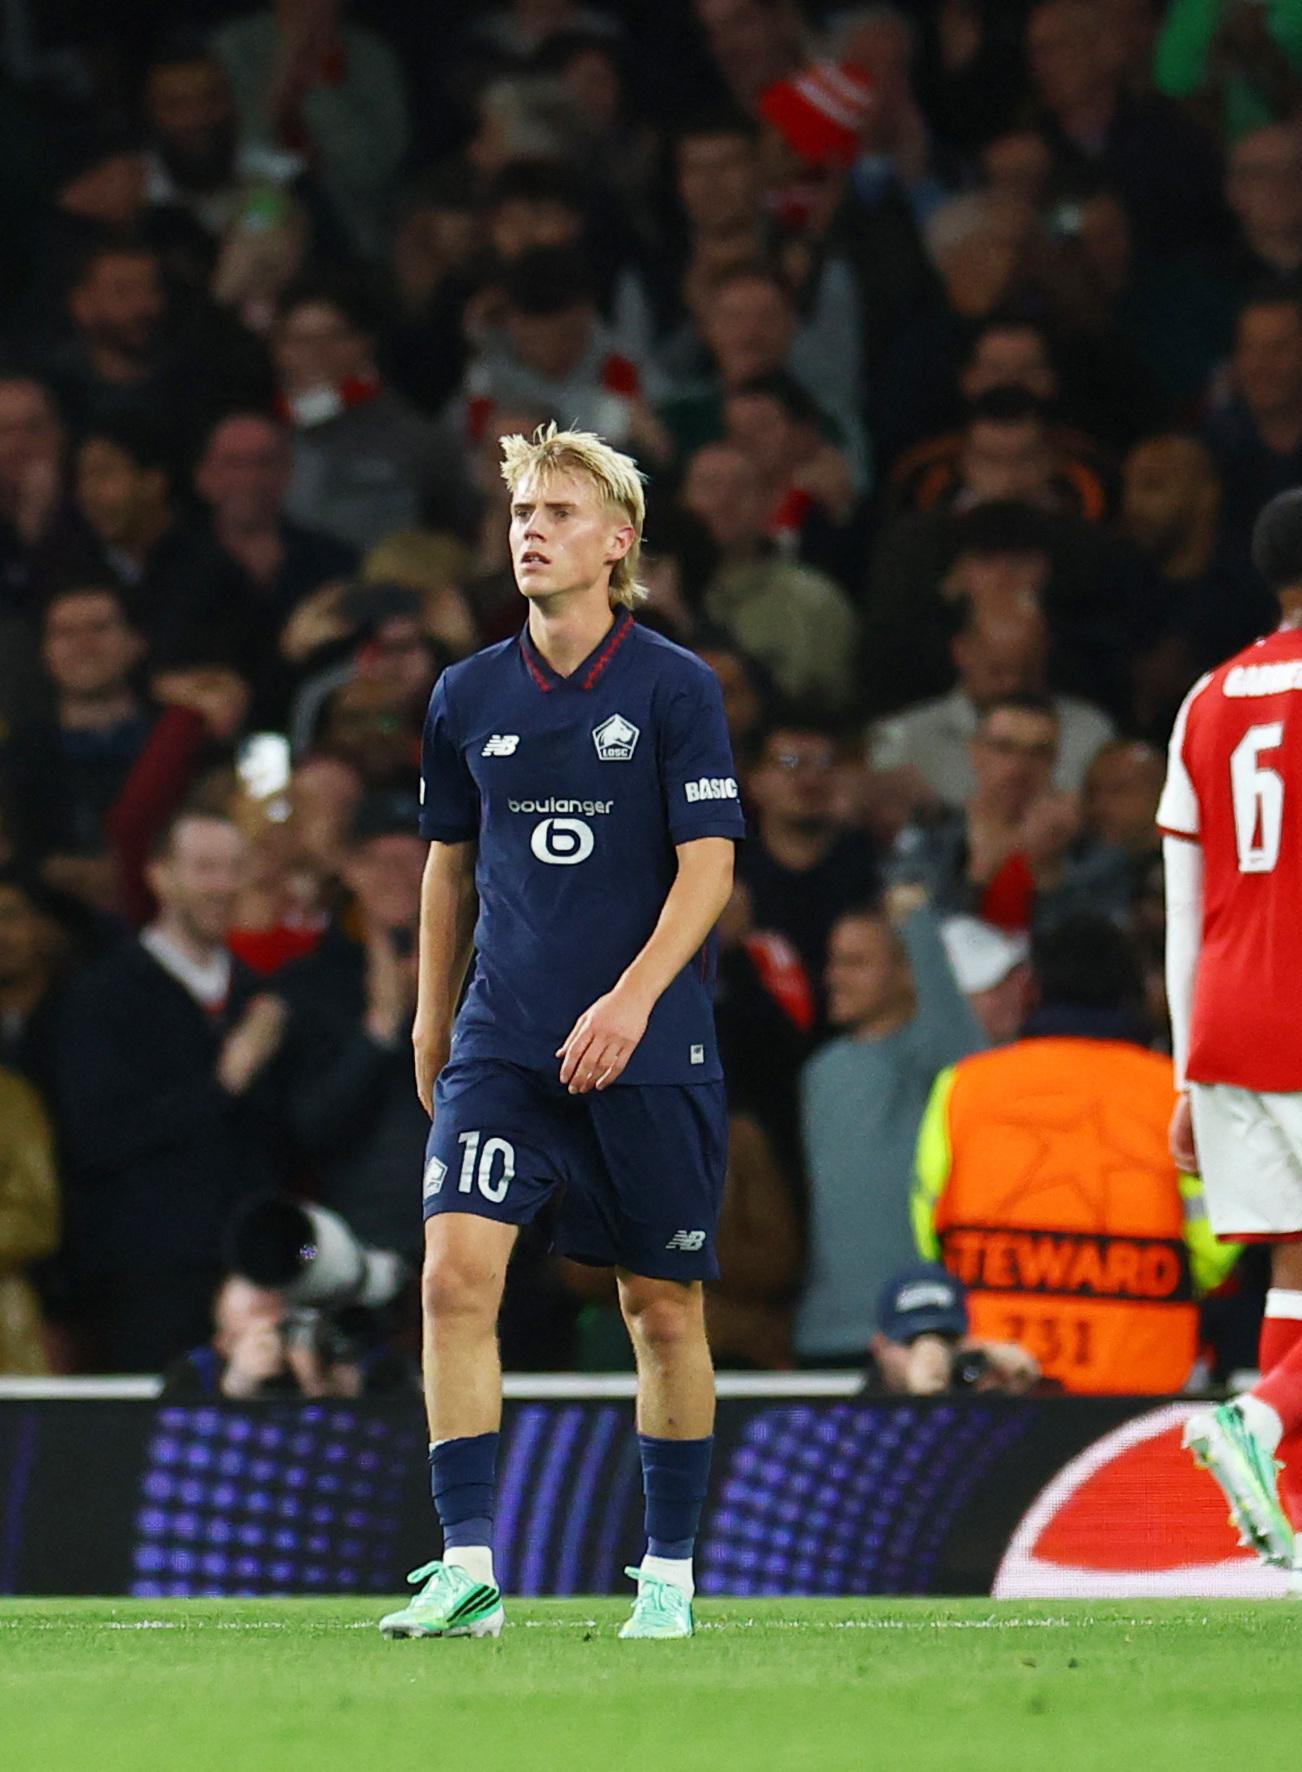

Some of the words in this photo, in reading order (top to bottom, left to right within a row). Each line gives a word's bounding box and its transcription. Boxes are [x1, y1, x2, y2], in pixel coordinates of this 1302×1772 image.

[602, 748, 629, 757] LOSC
[684, 777, 739, 803] BASIC
[1230, 720, 1285, 874] 6
[508, 798, 614, 816] boulanger
[457, 1130, 516, 1203] 10
